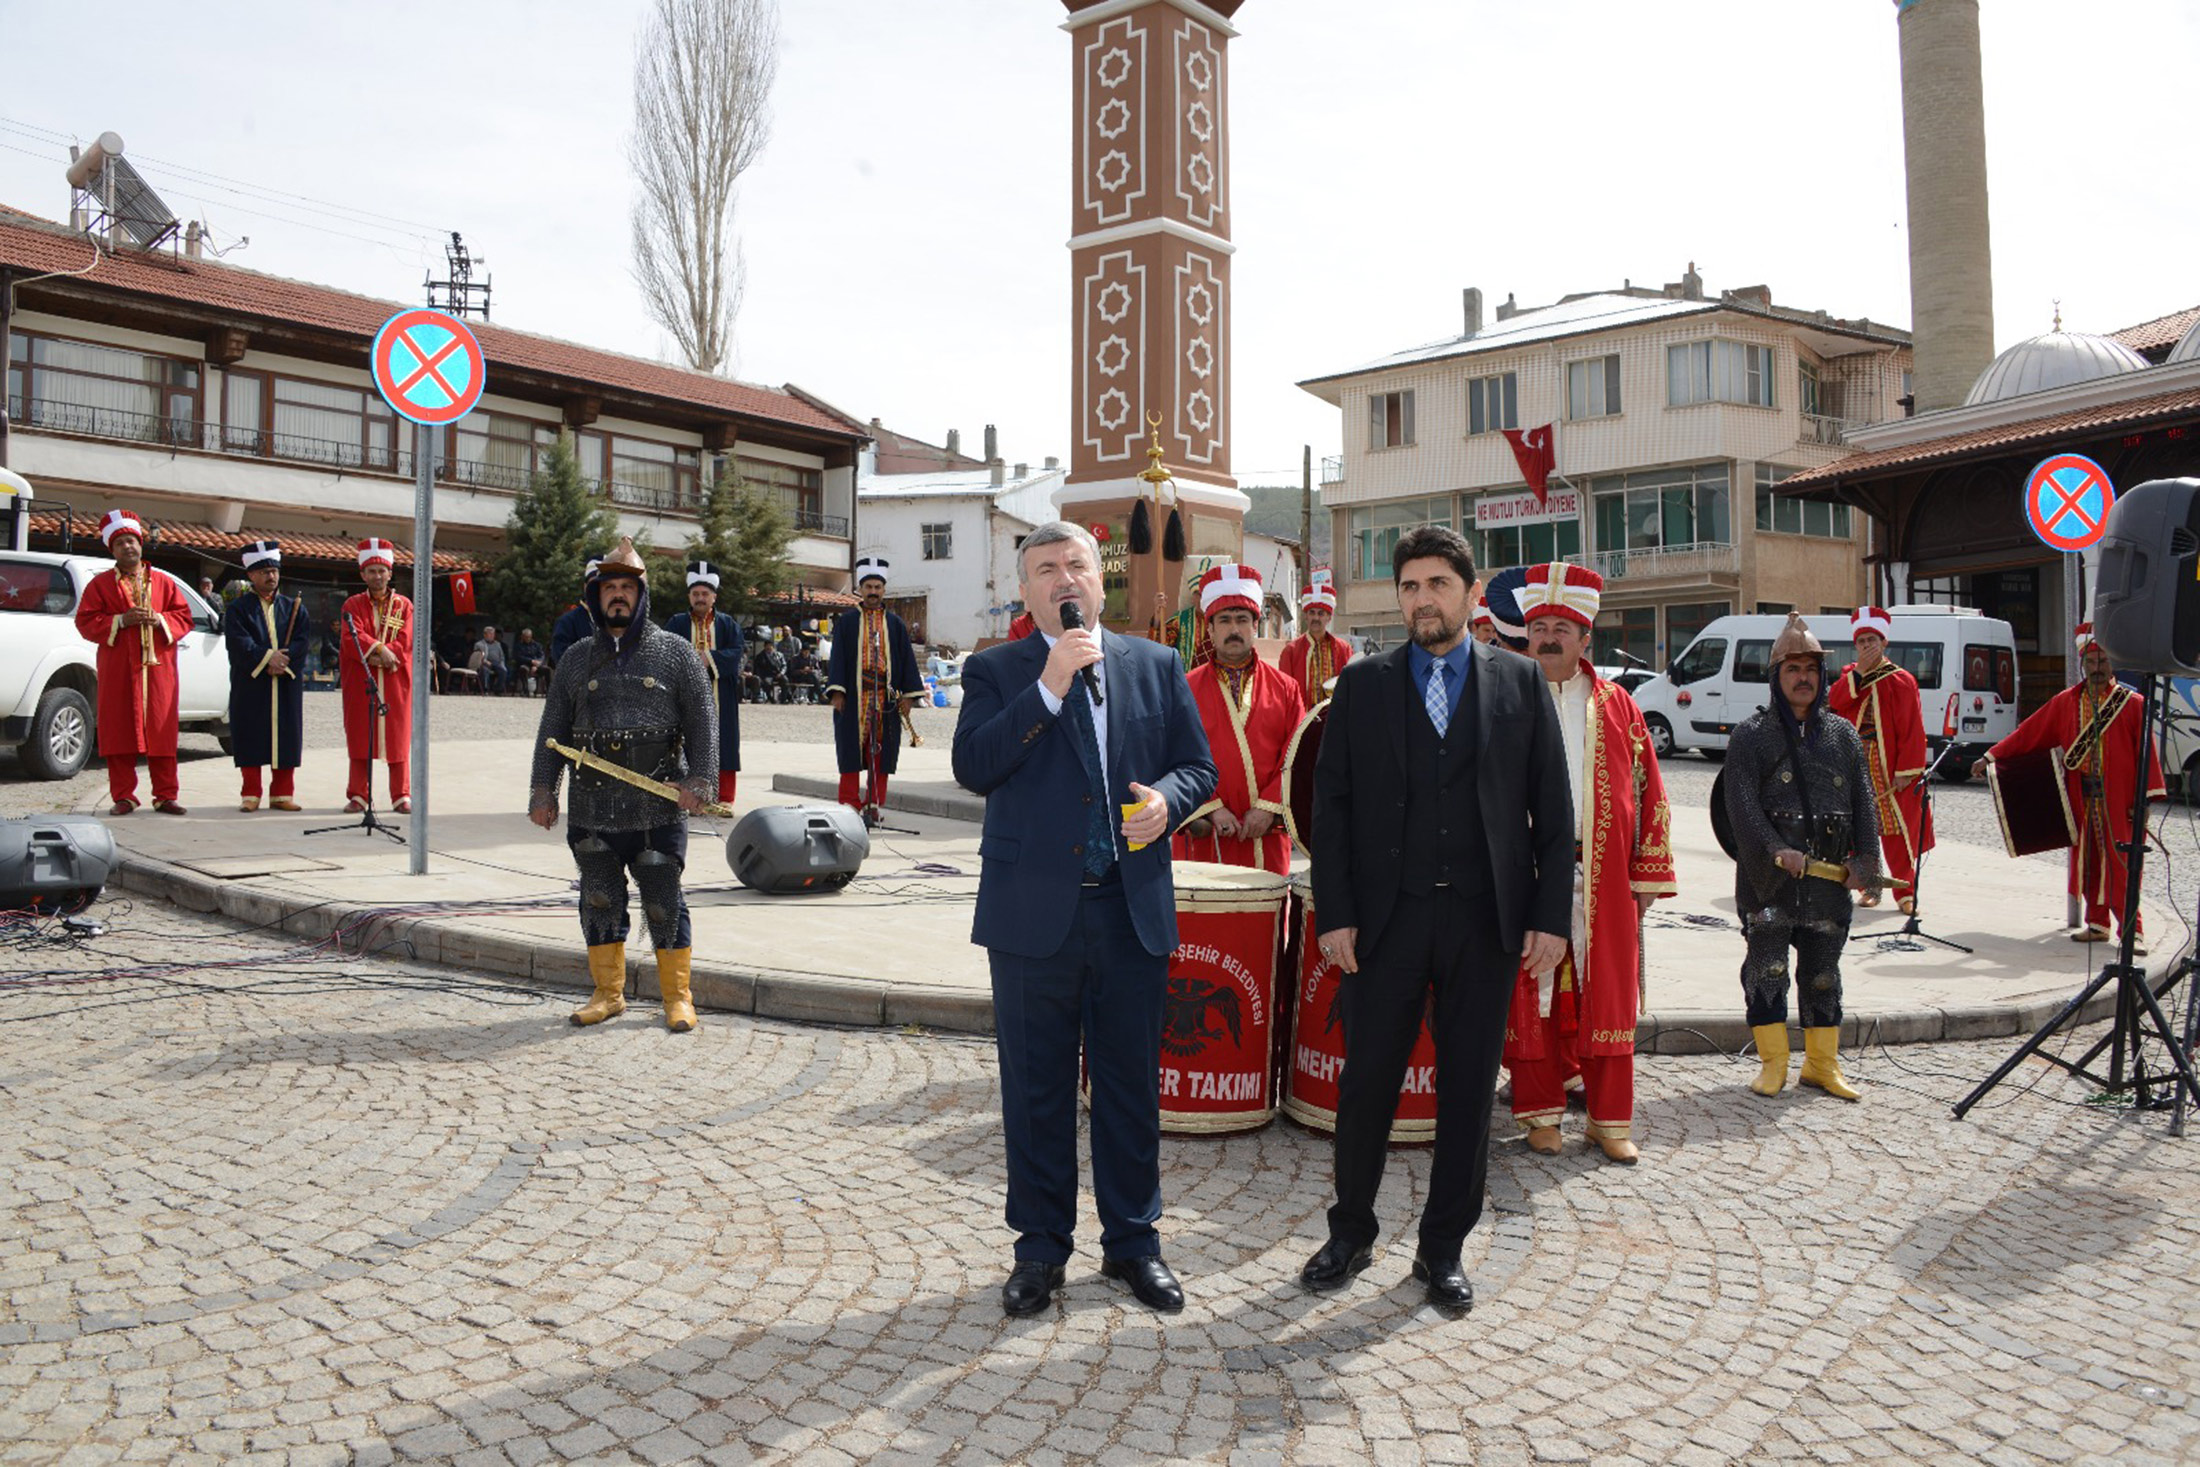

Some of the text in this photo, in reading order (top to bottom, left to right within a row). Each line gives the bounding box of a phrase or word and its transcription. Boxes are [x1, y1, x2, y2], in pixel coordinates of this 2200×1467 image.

[1477, 504, 1487, 521] NE
[1489, 501, 1513, 519] MUTLU
[1221, 953, 1265, 1026] BELEDİYESİ
[1187, 1070, 1261, 1101] TAKIMI
